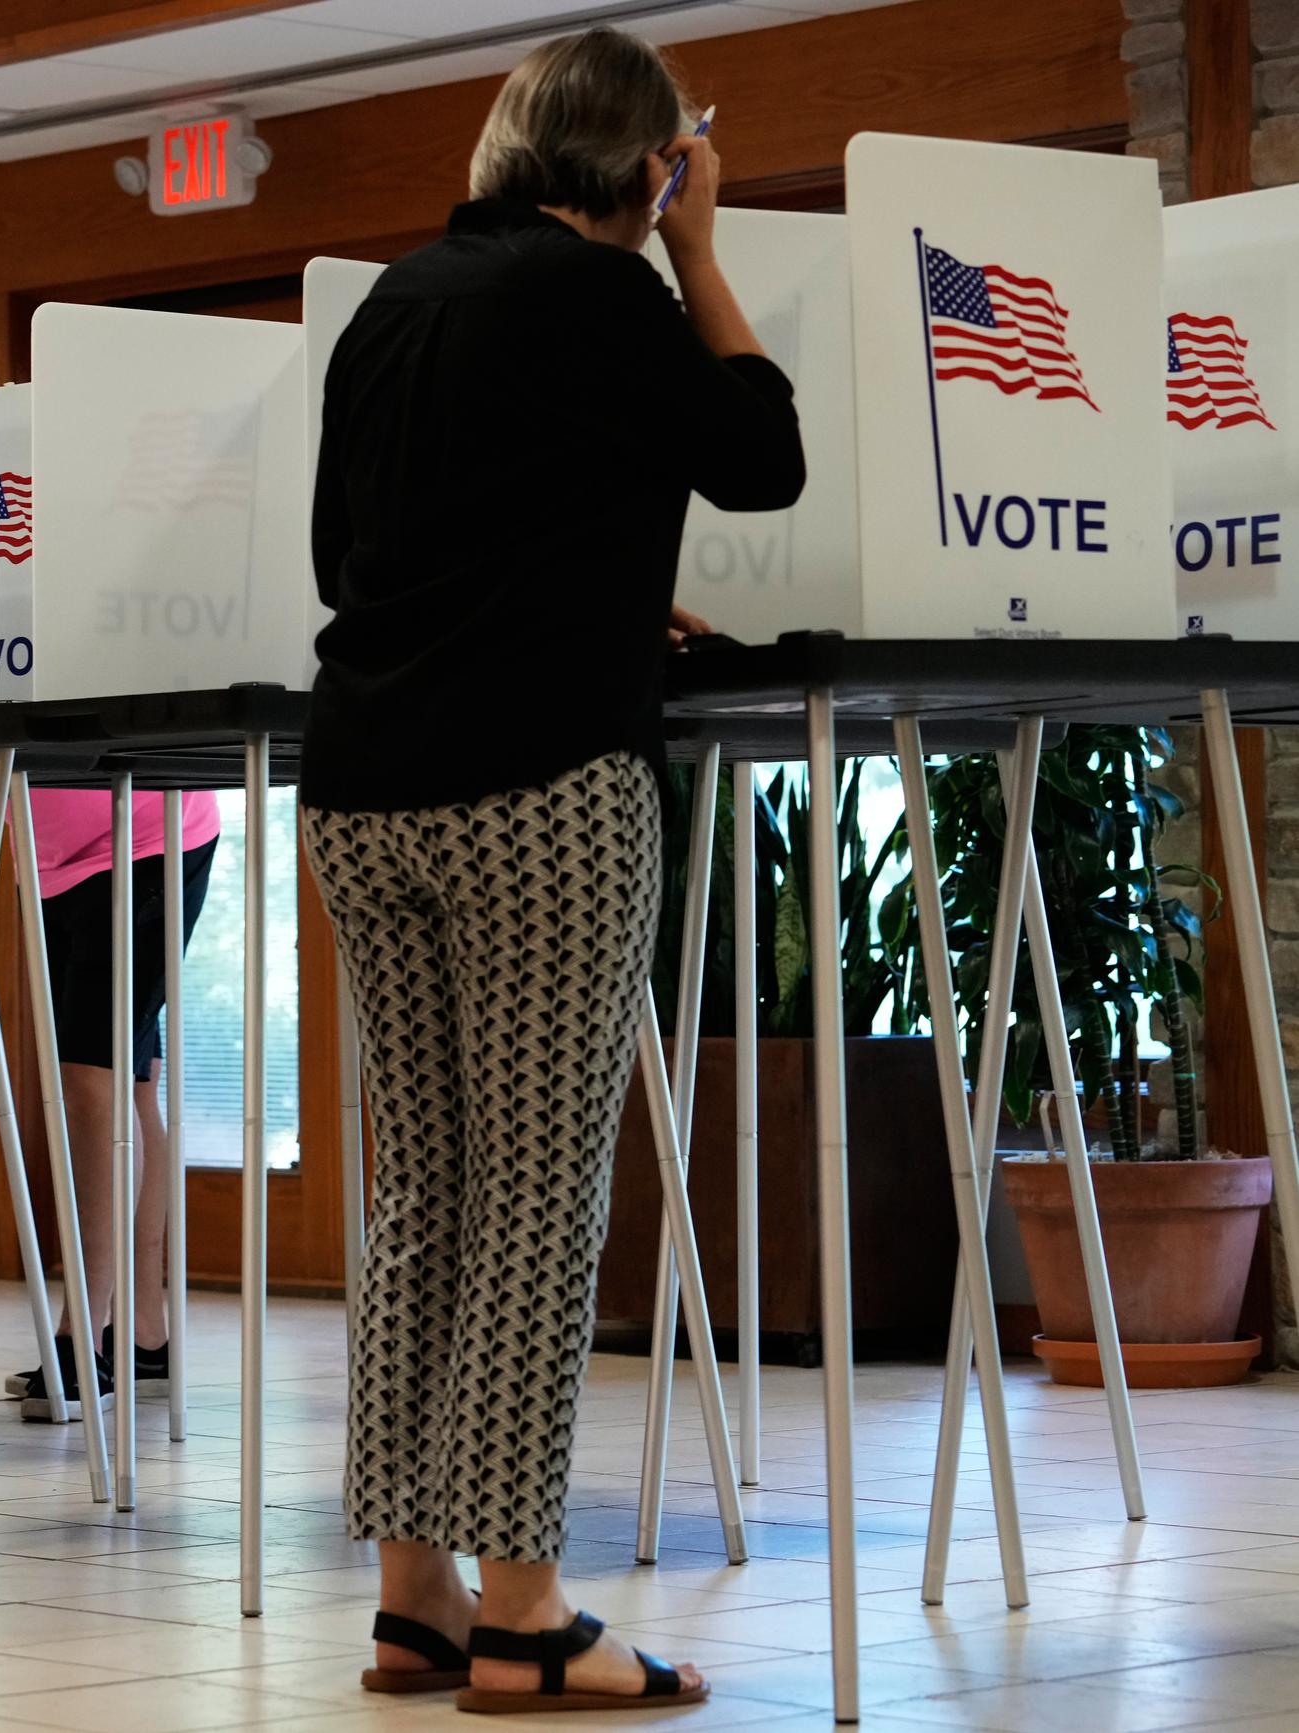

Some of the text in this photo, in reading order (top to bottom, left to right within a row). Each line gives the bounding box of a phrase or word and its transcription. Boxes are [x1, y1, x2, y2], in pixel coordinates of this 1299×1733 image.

[163, 119, 230, 206] EXIT
[953, 493, 1108, 553] VOTE
[1169, 513, 1282, 572] OTE
